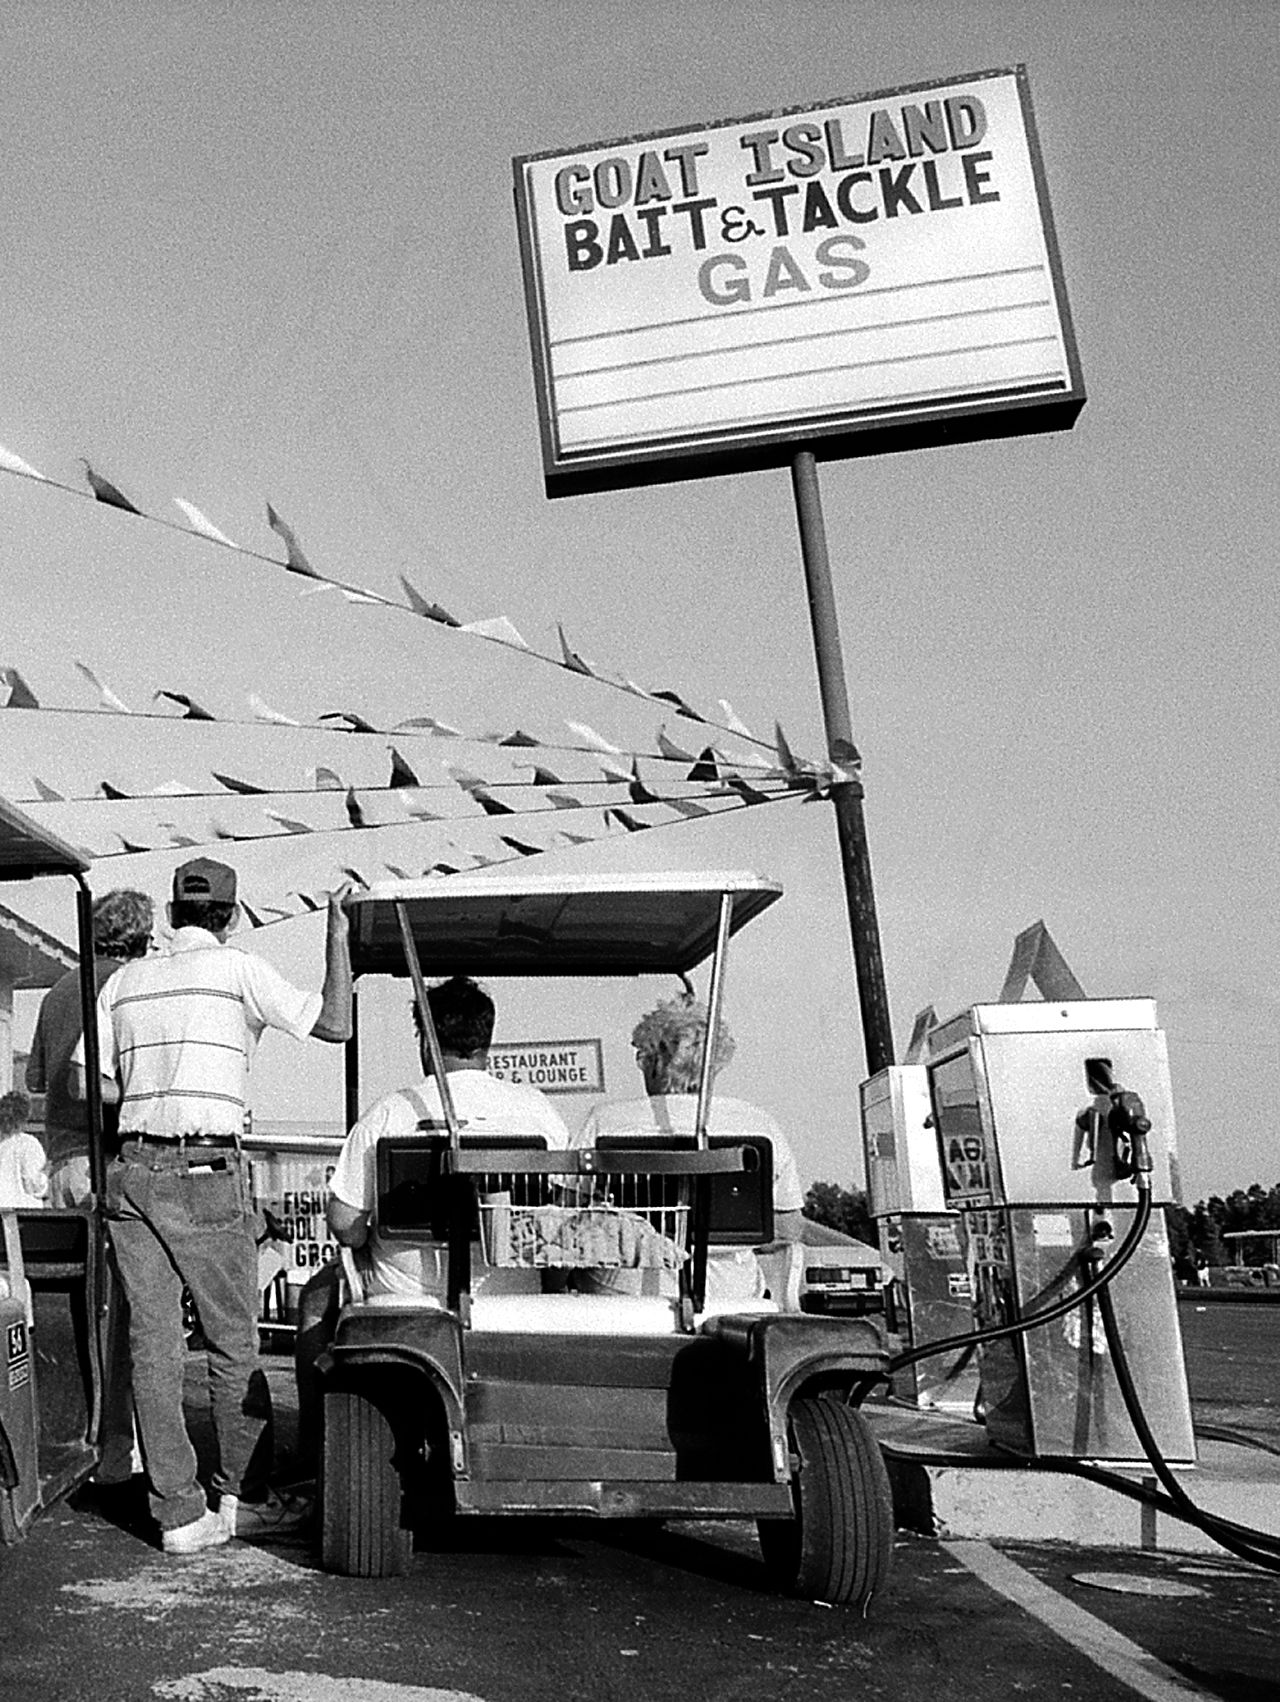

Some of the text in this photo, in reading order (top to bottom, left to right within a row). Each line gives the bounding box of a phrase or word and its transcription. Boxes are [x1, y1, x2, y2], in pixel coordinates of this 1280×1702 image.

[554, 95, 989, 217] GOAT ISLAND
[563, 197, 718, 272] BAIT
[752, 150, 1001, 238] TACKLE
[697, 233, 871, 306] GAS
[528, 1067, 589, 1084] LOUNGE
[295, 1243, 341, 1268] GRO
